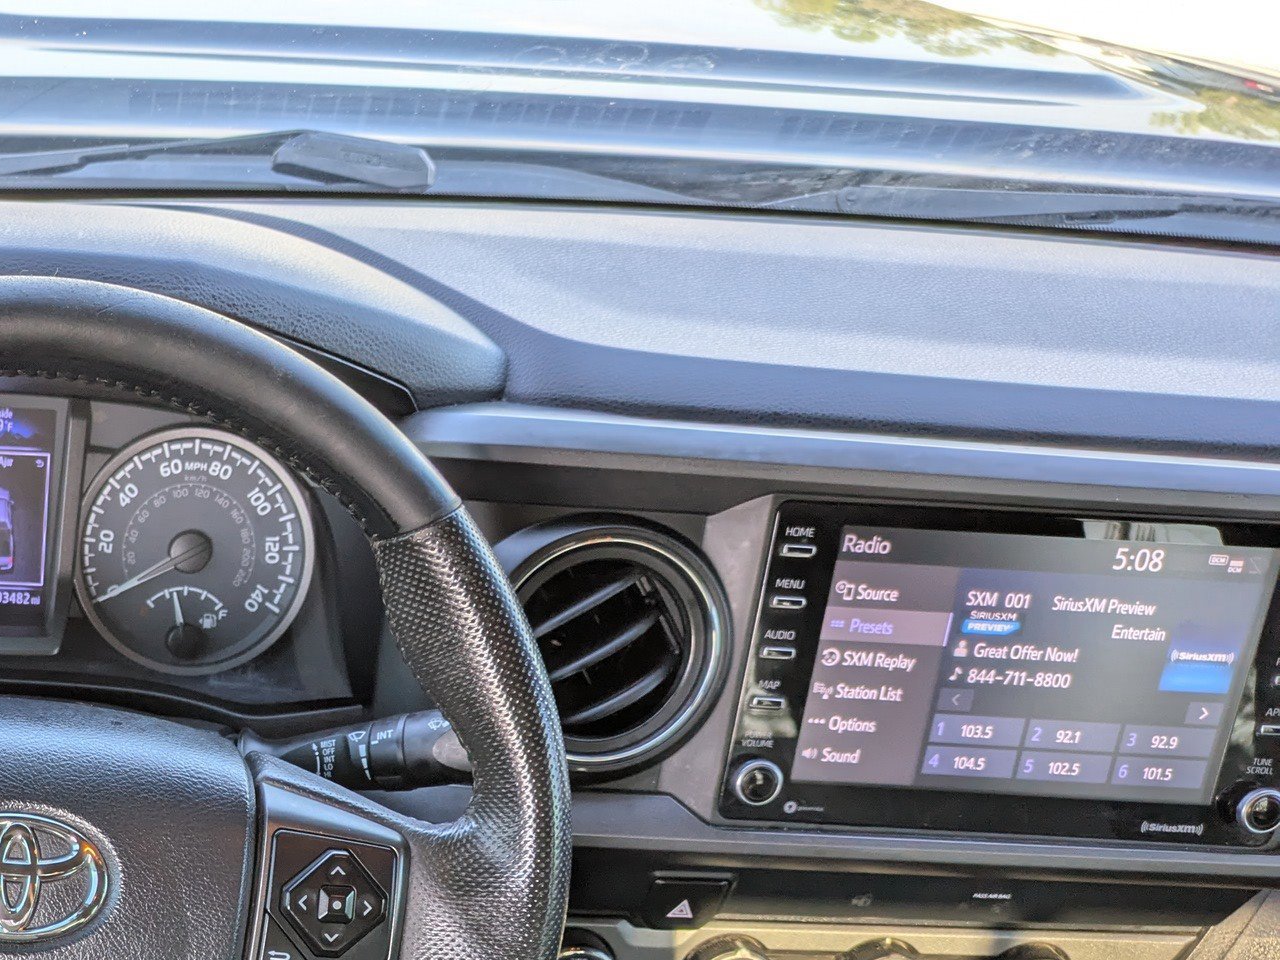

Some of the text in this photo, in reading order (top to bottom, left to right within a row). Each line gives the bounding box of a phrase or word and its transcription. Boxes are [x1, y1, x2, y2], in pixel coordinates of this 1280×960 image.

[160, 459, 183, 478] 60
[184, 462, 208, 472] MPH
[208, 461, 233, 480] 80
[119, 484, 138, 508] 40
[172, 488, 189, 498] 100
[195, 489, 210, 499] 120
[153, 496, 167, 508] 80
[214, 496, 230, 509] 140
[247, 487, 271, 516] 100
[137, 510, 150, 523] 60
[230, 508, 243, 525] 160
[128, 529, 139, 543] 40
[785, 526, 815, 537] HOME
[99, 529, 114, 553] 20
[842, 534, 892, 554] Radio
[265, 536, 280, 564] 120
[126, 552, 136, 565] 20
[1112, 547, 1165, 573] 5:08
[775, 578, 805, 589] MENU
[244, 584, 268, 613] 140
[857, 585, 899, 602] Source
[966, 591, 1156, 616] SXM 001 SiriusXM Preview
[219, 608, 228, 619] F
[970, 610, 1017, 621] SIRIUSXM
[764, 629, 796, 640] AUDIO
[849, 618, 893, 635] Presets
[1111, 624, 1166, 641] Entertain
[973, 643, 1079, 663] Great Offer Now!
[842, 651, 917, 672] SXM Replay
[758, 680, 781, 690] MAP
[967, 668, 1071, 688] 844-711-8800
[835, 683, 903, 702] Station List
[1265, 708, 1280, 717] AP
[828, 715, 877, 734] Options
[937, 721, 994, 739] 1 103.5
[376, 729, 394, 741] INT
[741, 738, 774, 748] VOLUME
[1031, 727, 1082, 744] 2 92.1
[1126, 733, 1179, 749] 3 92.9
[320, 739, 336, 749] MIST
[322, 748, 335, 756] OFF
[323, 755, 335, 763] INT
[821, 747, 861, 764] Sound
[928, 754, 986, 771] 4 104.5
[1253, 758, 1273, 766] TUNE
[323, 763, 333, 771] LO
[1023, 759, 1080, 776] 5 102.5
[1118, 765, 1173, 781] 6 101.5
[1246, 766, 1273, 775] SCROLL
